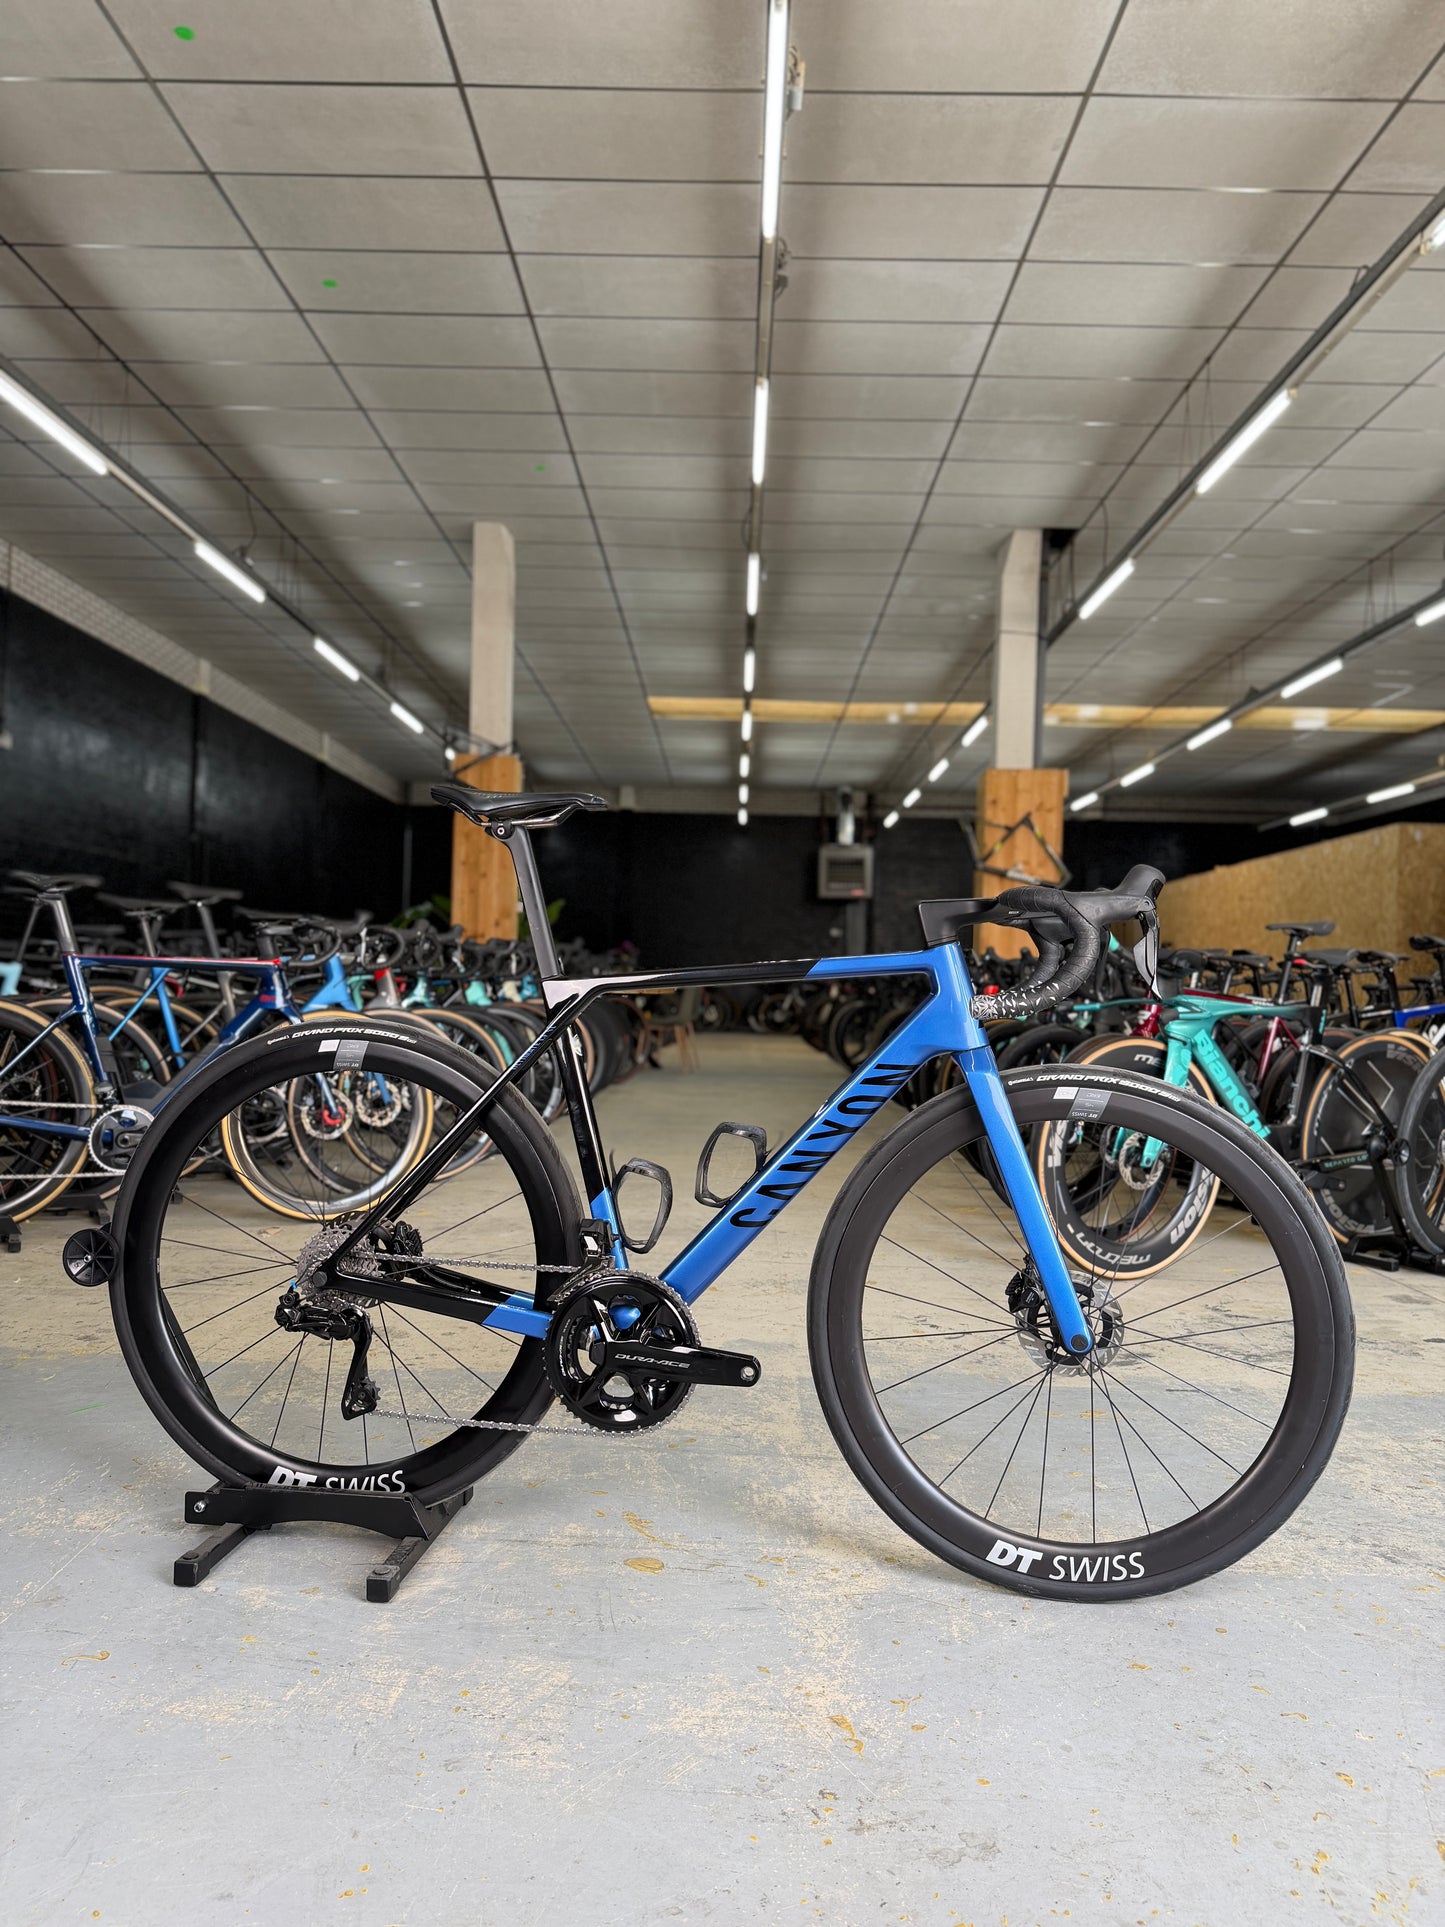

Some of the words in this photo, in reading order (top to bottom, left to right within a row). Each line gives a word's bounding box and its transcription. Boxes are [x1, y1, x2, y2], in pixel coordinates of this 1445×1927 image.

[291, 1027, 334, 1039] GRAND
[1036, 1074, 1085, 1082] GRAND
[1083, 1075, 1120, 1085] PRIX
[1193, 1029, 1272, 1139] Bianchi
[729, 1063, 921, 1229] CANYON
[614, 1353, 691, 1369] DURA-ACE
[267, 1465, 318, 1488] DT
[985, 1539, 1044, 1574] DT
[1048, 1551, 1146, 1582] SWISS
